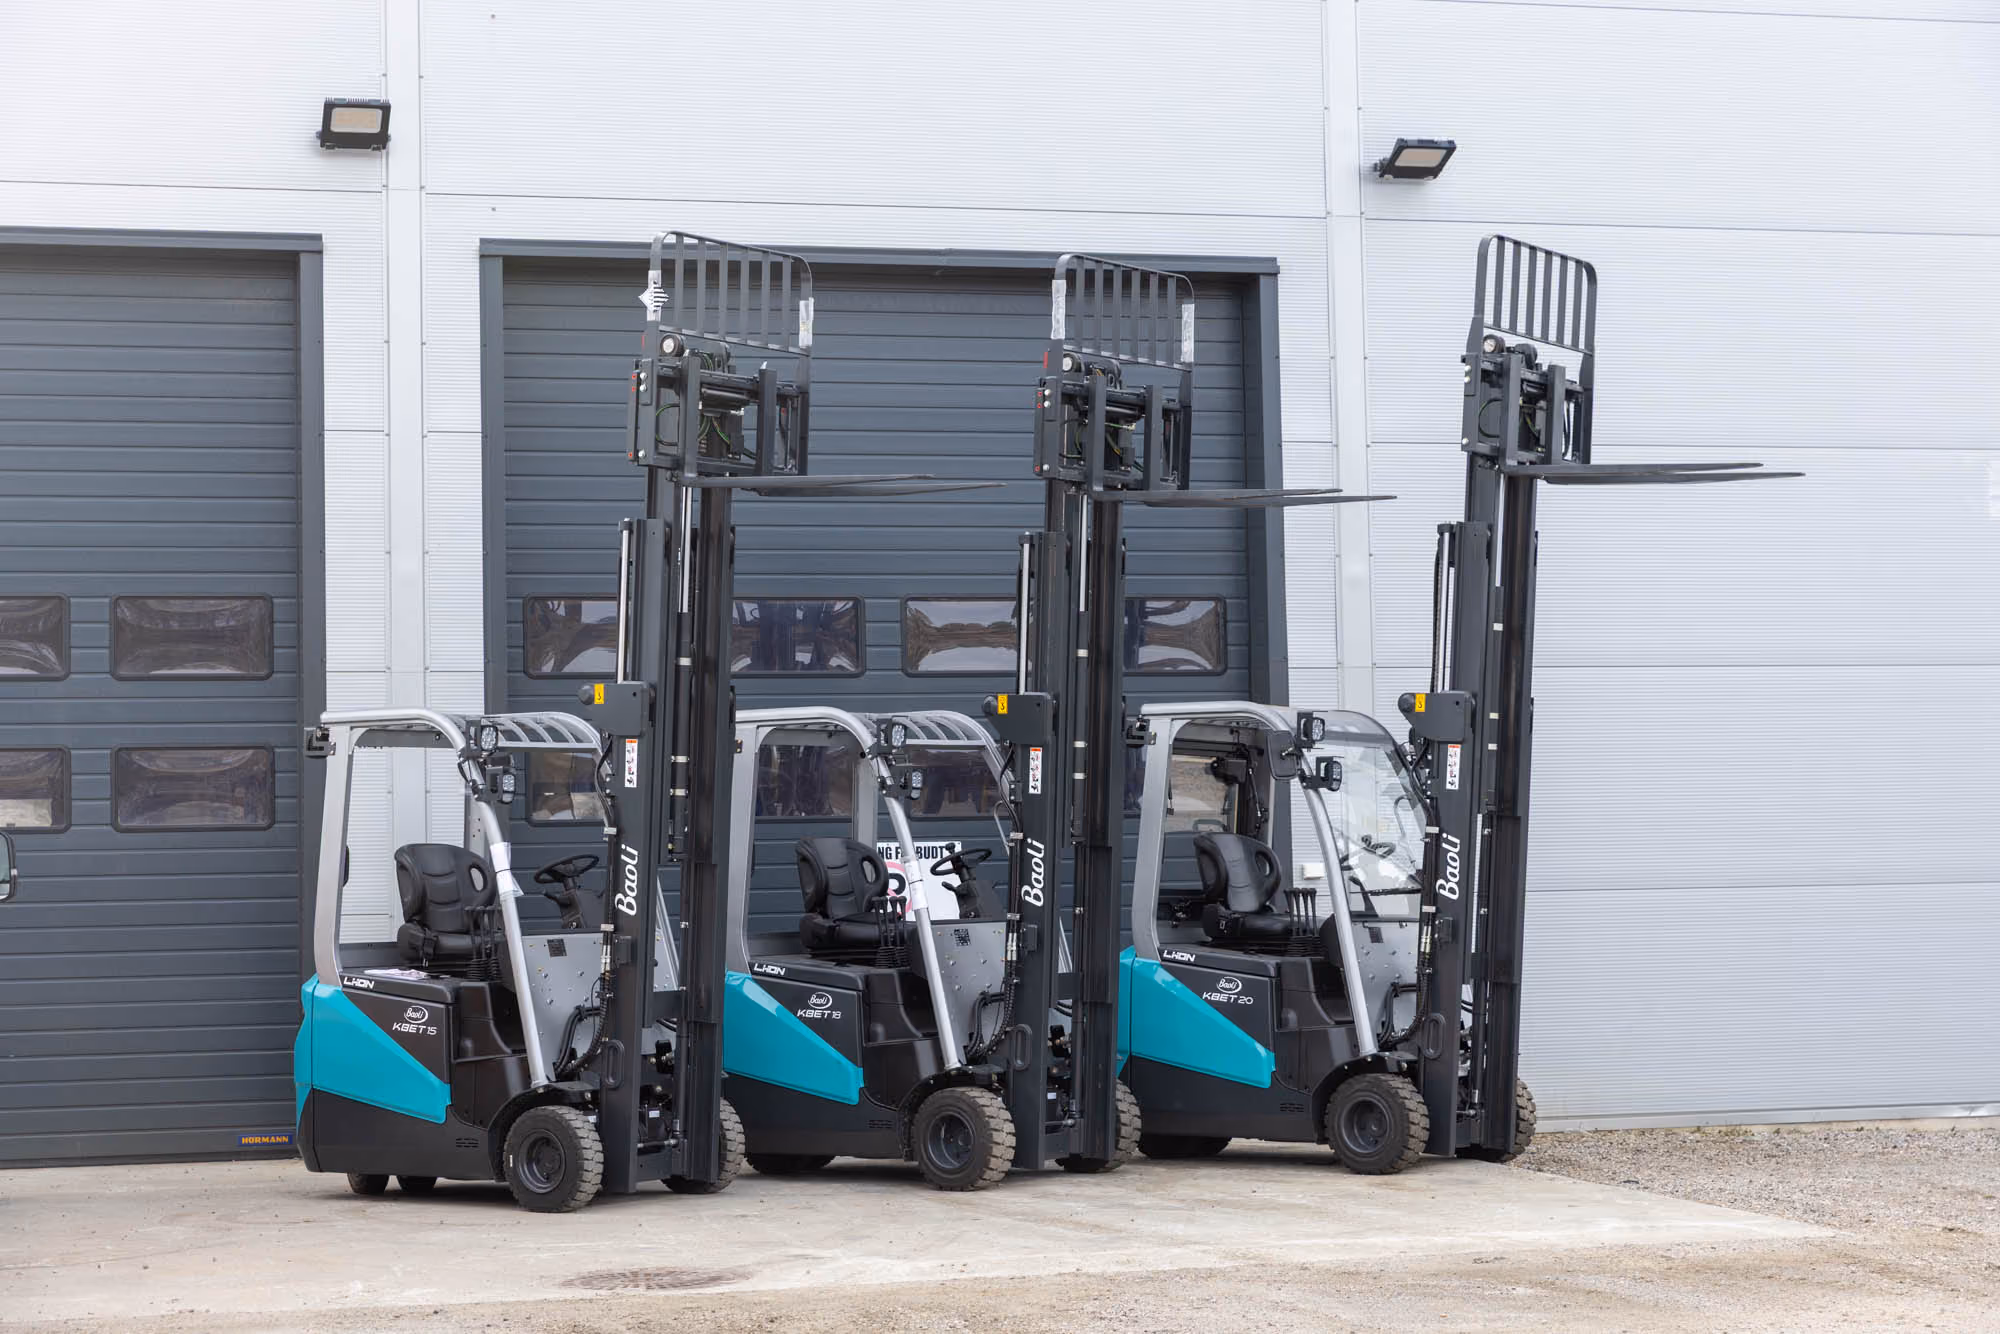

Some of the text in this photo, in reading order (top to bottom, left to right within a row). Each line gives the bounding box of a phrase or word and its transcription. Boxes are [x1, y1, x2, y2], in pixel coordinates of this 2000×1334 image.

[614, 843, 639, 916] Baoli
[1021, 837, 1045, 907] Baoli
[1435, 832, 1460, 901] Baoli
